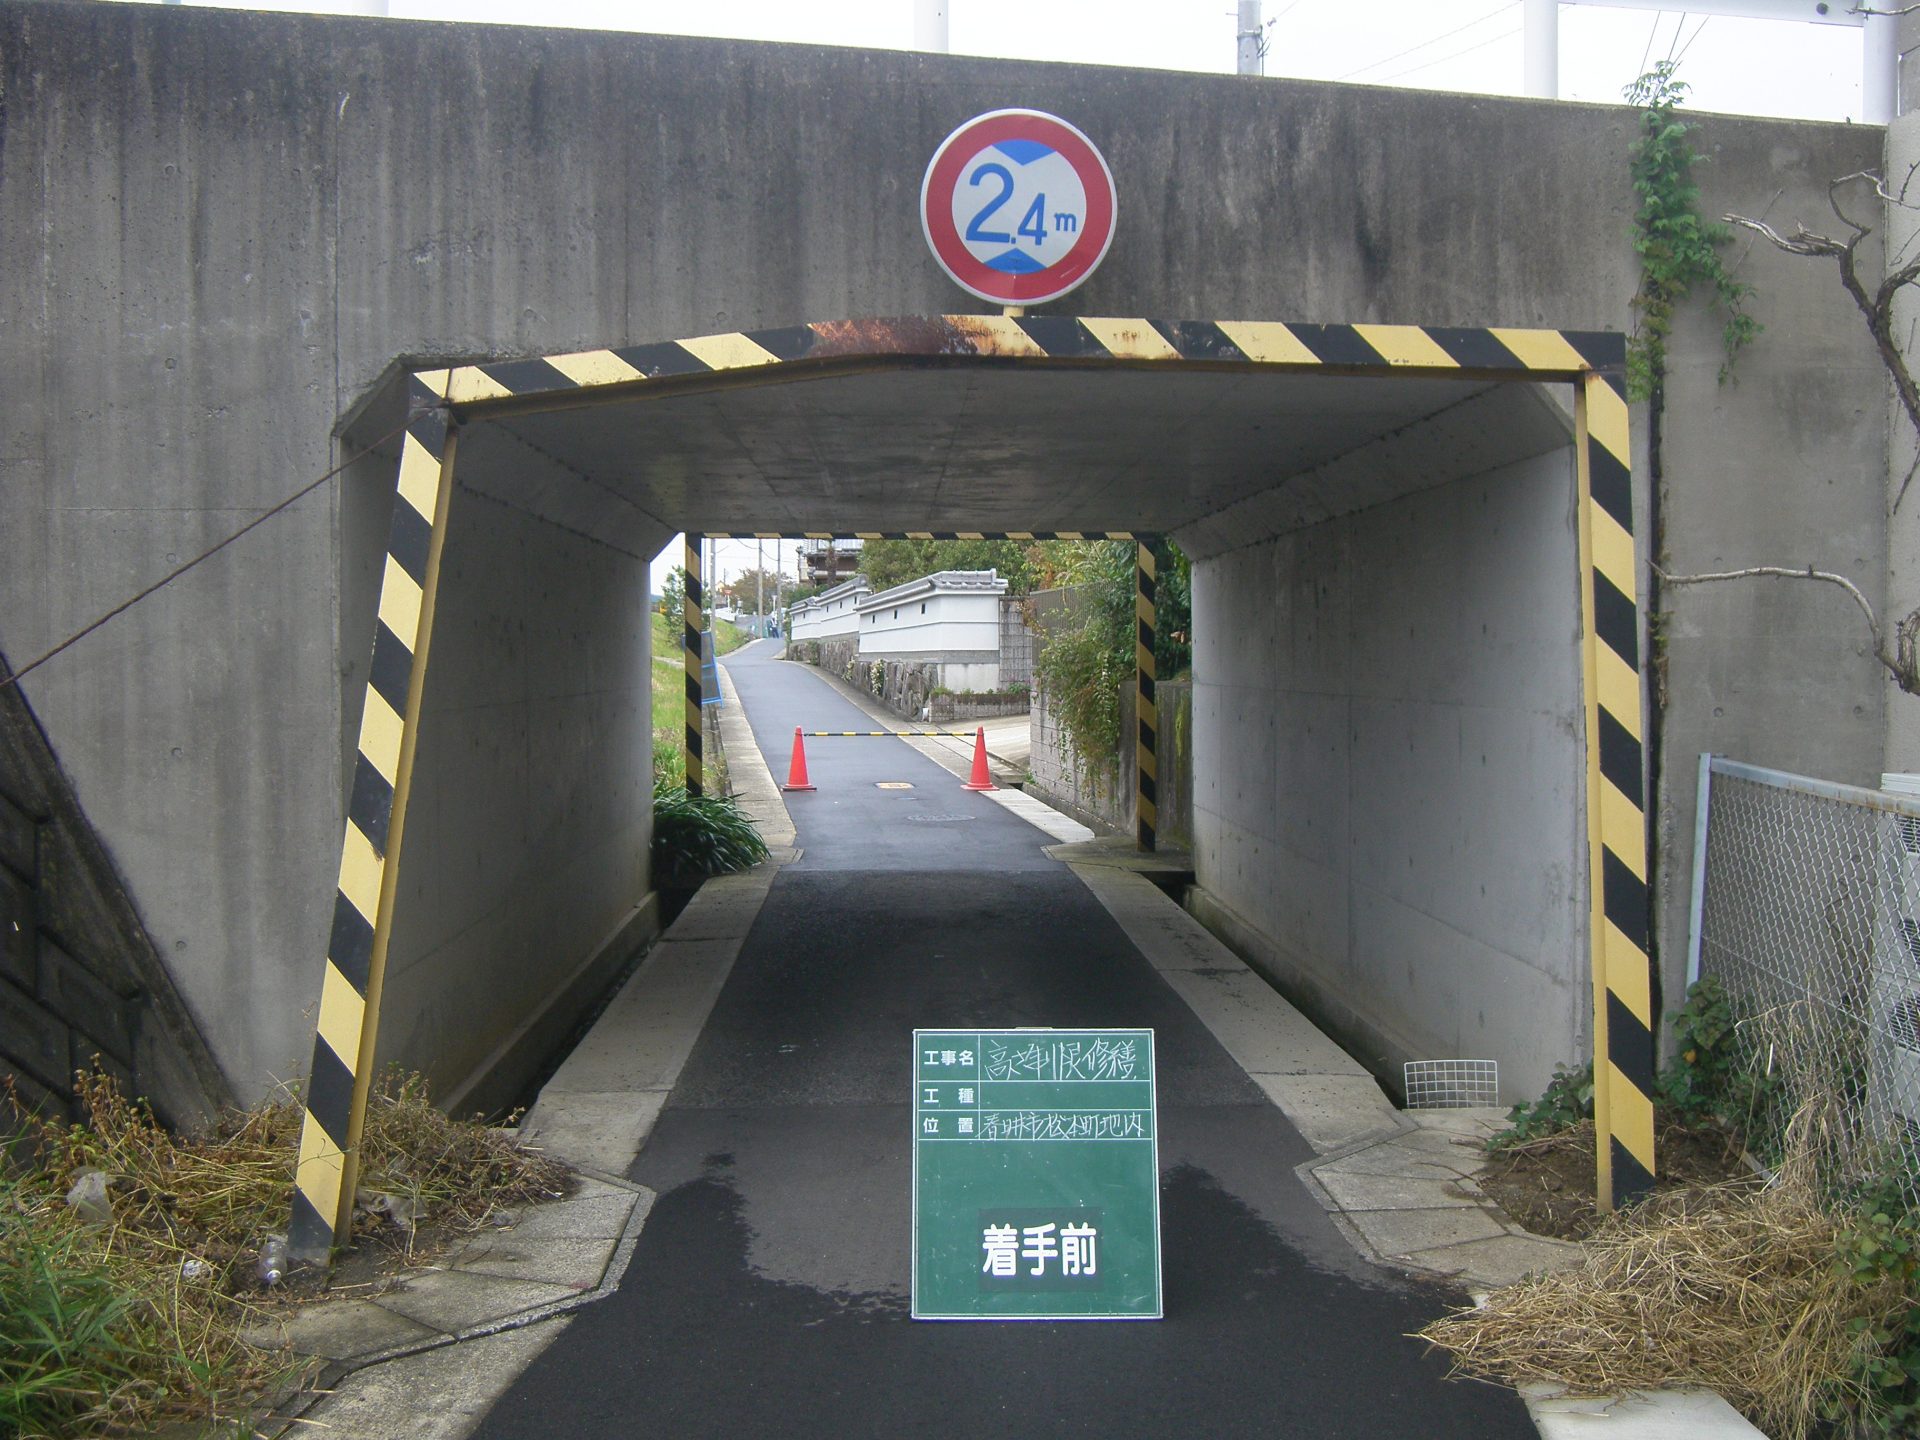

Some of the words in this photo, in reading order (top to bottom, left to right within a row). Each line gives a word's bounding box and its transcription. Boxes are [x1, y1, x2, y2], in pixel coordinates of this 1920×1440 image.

[923, 1050, 974, 1066] 工事名
[982, 1221, 1097, 1276] 着手前
